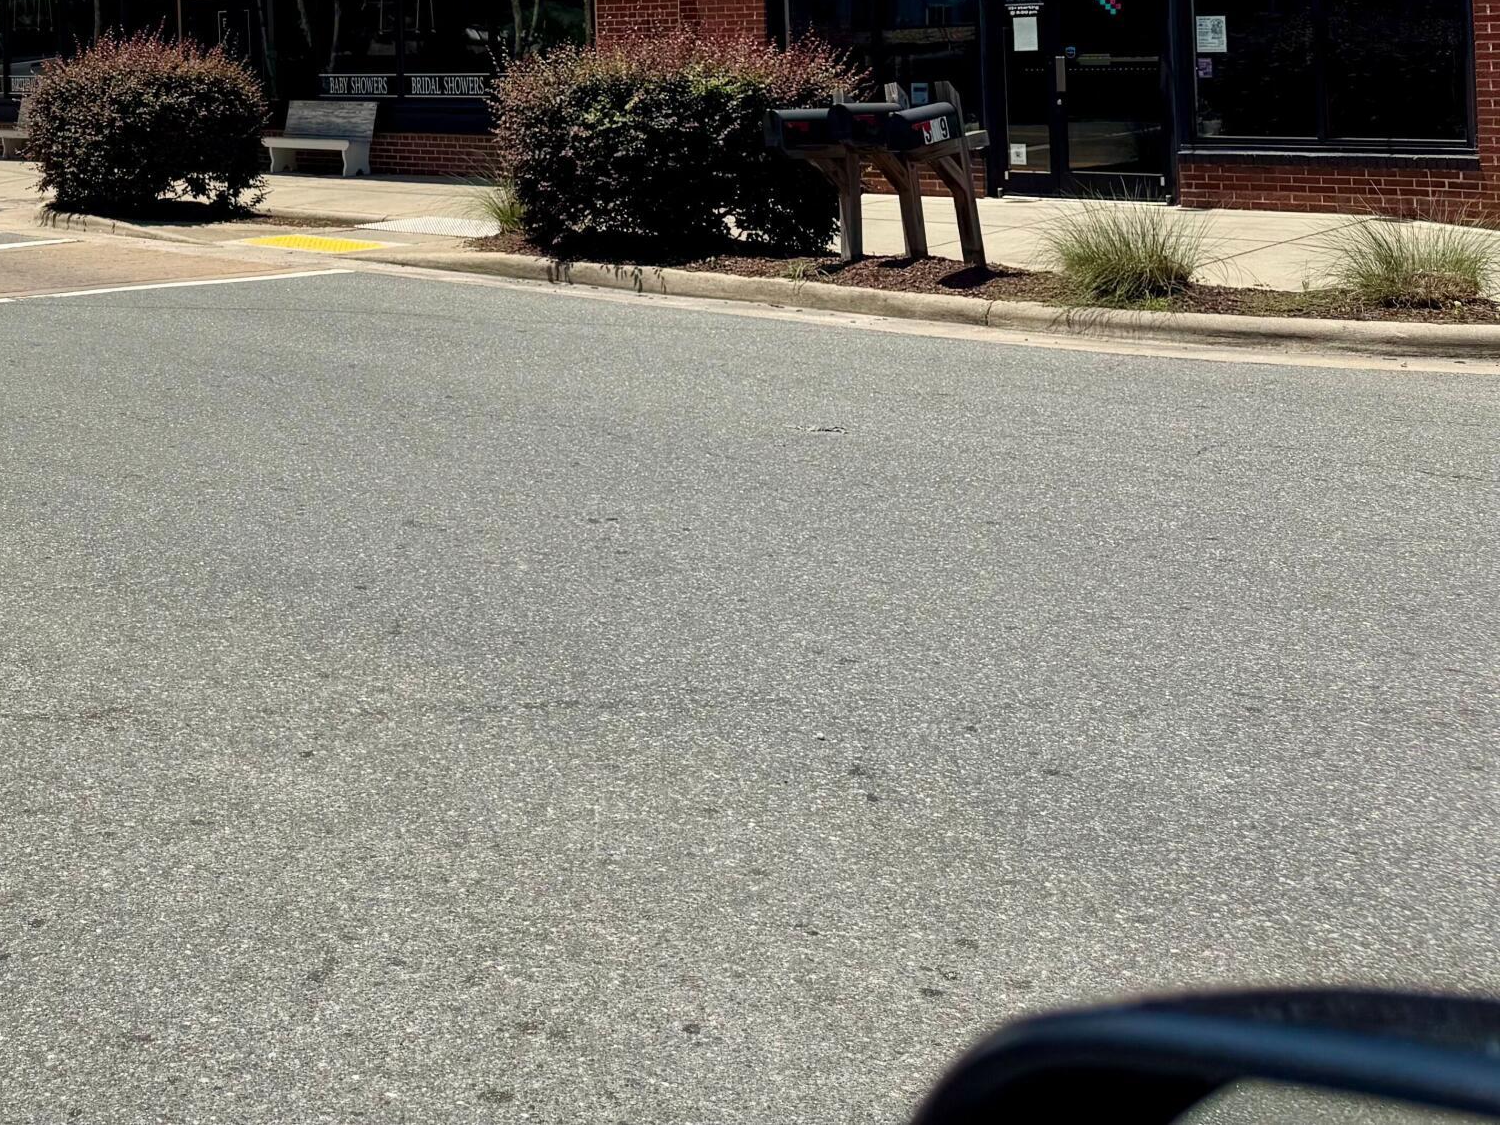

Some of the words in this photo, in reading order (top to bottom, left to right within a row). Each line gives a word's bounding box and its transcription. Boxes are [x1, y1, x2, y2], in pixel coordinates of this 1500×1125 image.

[329, 77, 348, 94] BABY
[351, 77, 388, 94] SHOWERS
[411, 77, 442, 94] BRIDAL
[444, 77, 485, 94] SHOWERS
